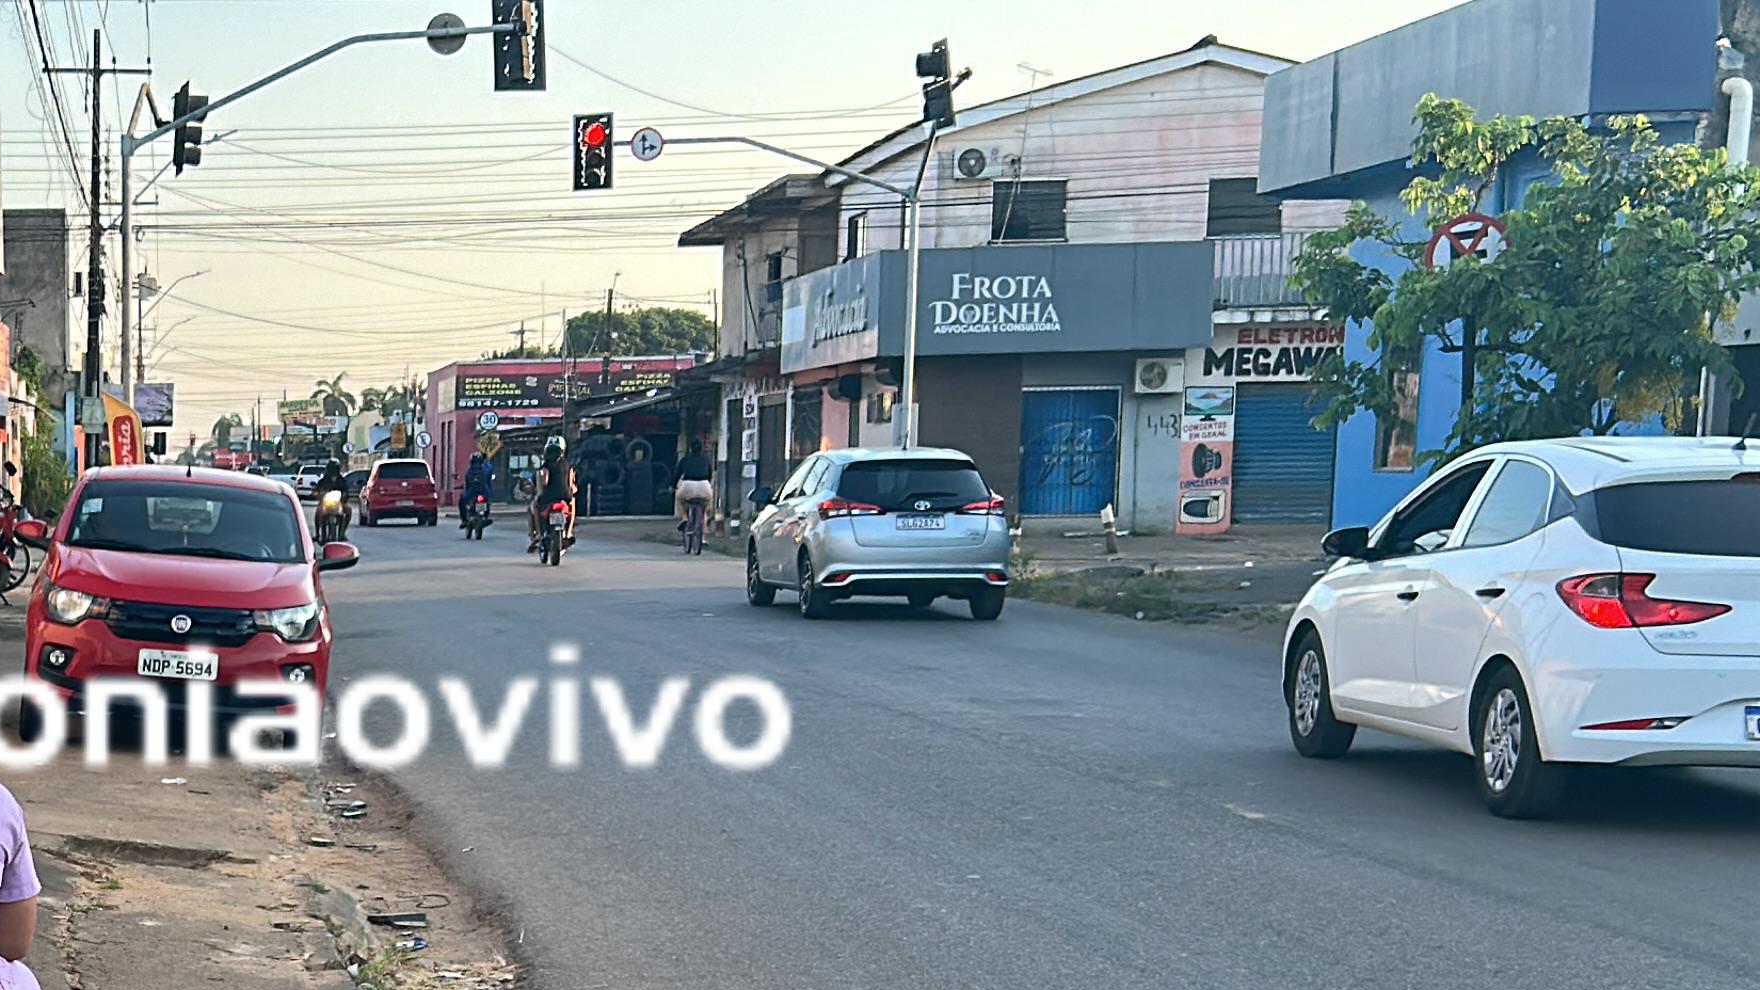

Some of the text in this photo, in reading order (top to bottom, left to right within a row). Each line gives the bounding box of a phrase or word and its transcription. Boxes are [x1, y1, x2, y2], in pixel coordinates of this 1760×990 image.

[951, 273, 1052, 299] FROTA
[928, 301, 1059, 325] DOENHA
[934, 322, 1061, 334] ADVOCACIA E CONSULTORIA
[483, 415, 496, 424] 30
